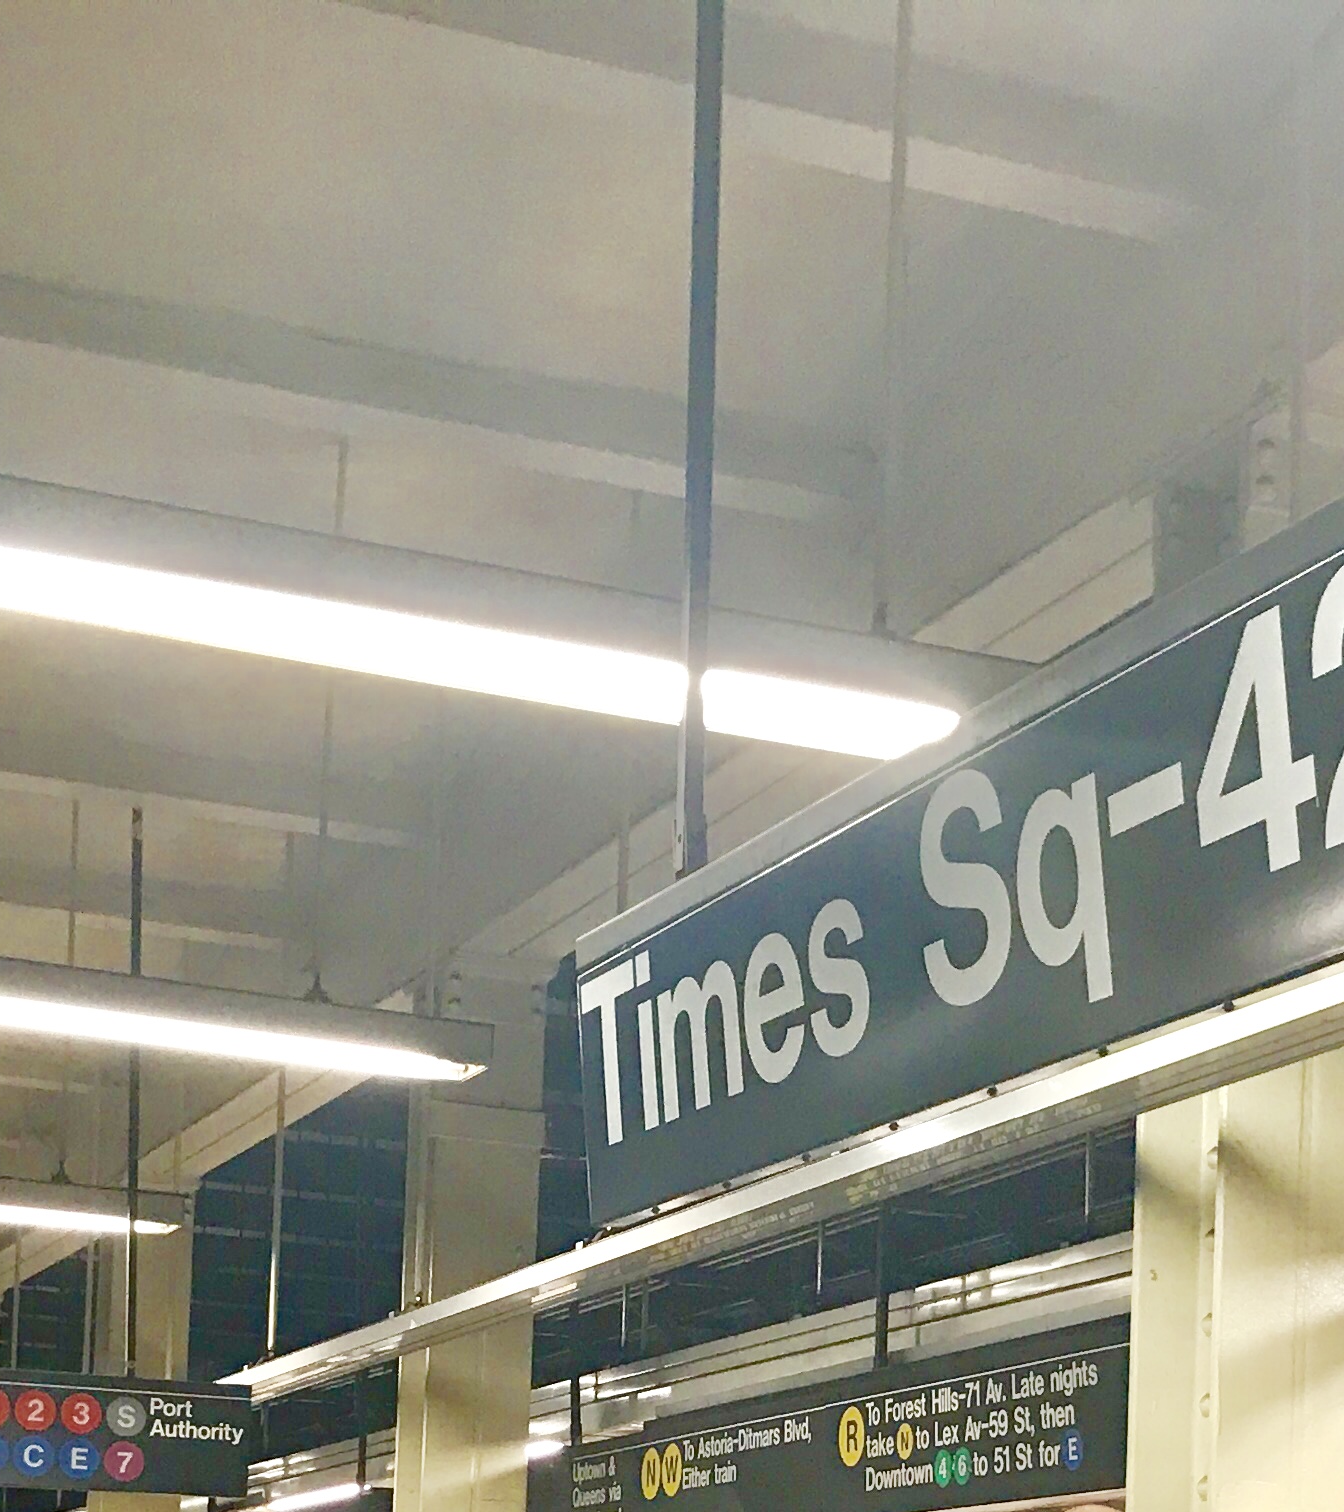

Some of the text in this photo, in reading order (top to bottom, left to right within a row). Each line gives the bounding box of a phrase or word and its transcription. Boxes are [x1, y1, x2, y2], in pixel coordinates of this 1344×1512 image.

[580, 896, 872, 1144] Times
[149, 1397, 193, 1418] Port
[866, 1360, 1098, 1426] To Forest Hills-71 Av. Late nights
[149, 1420, 244, 1445] Authority
[682, 1416, 812, 1461] To Astoria-Ditmars Blvd,
[866, 1432, 894, 1458] take
[916, 1426, 930, 1450] to
[934, 1421, 959, 1447] Lex
[965, 1409, 1008, 1442] Av-59
[1014, 1406, 1036, 1437] St,
[1040, 1402, 1075, 1430] then
[572, 1462, 606, 1485] Uptown
[682, 1459, 737, 1490] Either train
[865, 1462, 934, 1491] Downtown
[973, 1451, 988, 1476] to
[994, 1445, 1010, 1474] 51
[1016, 1442, 1033, 1471] St
[1038, 1440, 1061, 1467] for
[572, 1481, 622, 1508] Queens via
